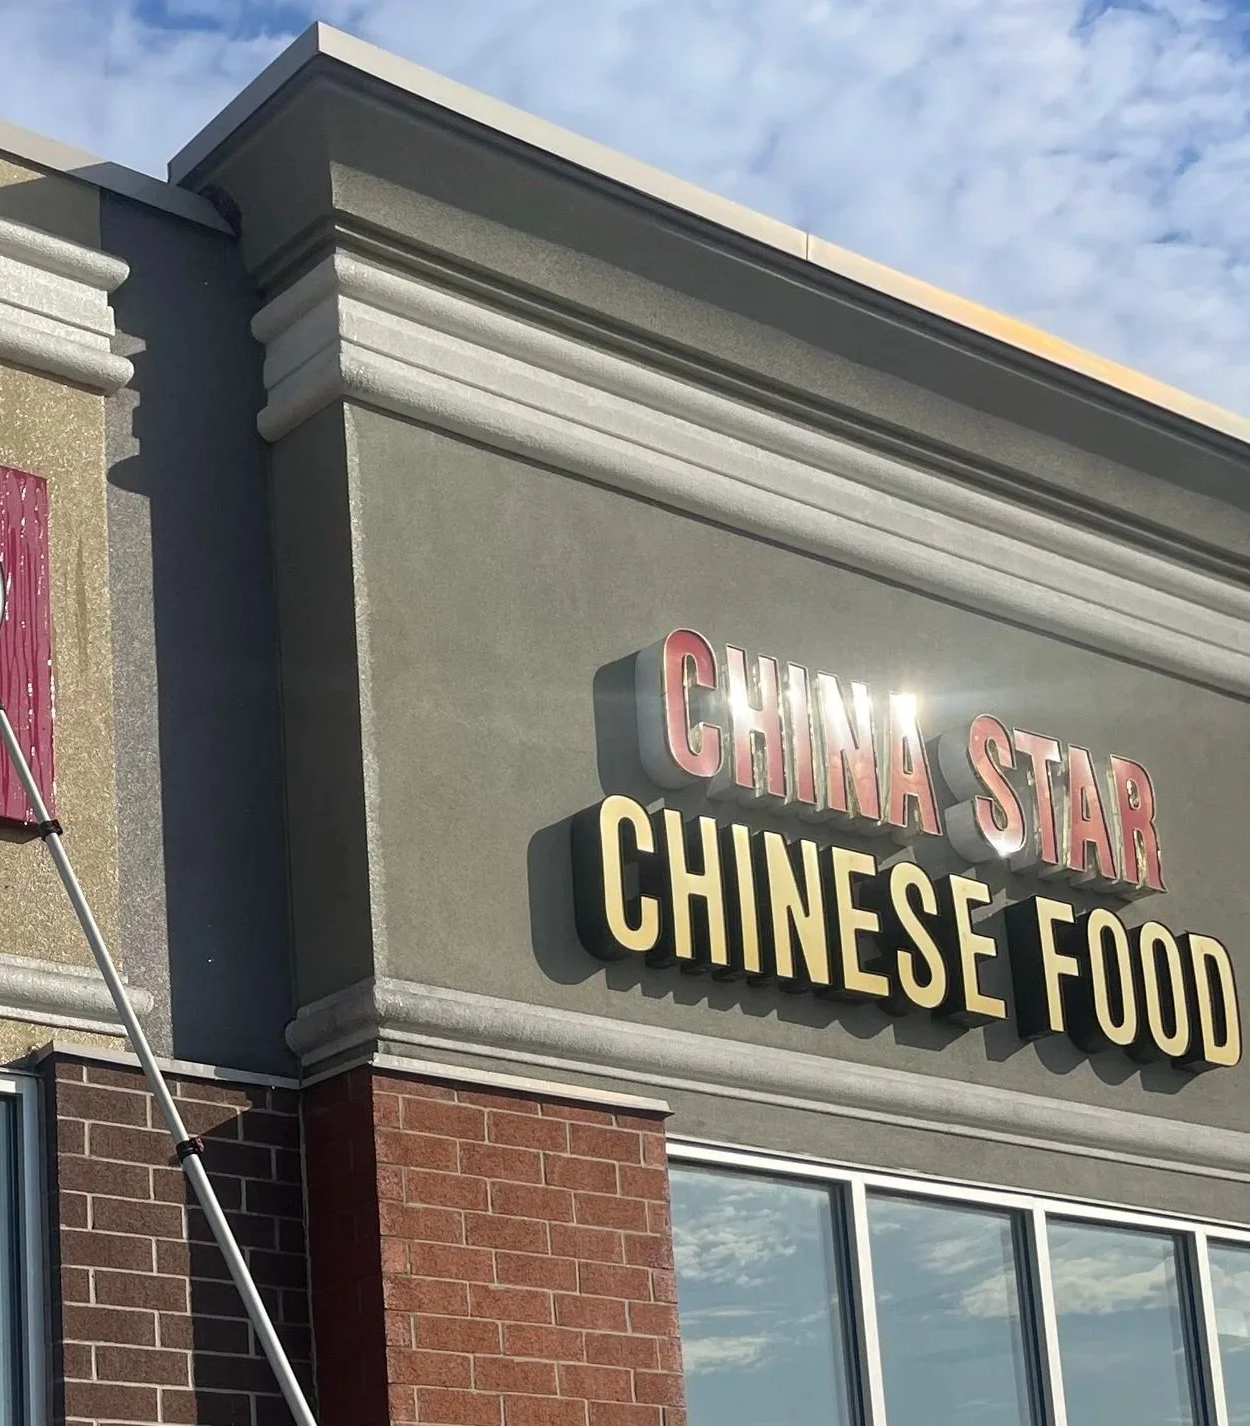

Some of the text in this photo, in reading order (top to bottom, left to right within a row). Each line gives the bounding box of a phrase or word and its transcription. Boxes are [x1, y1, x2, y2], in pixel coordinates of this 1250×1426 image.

[662, 628, 1167, 892] CHINA STAR
[598, 794, 1242, 1067] CHINESE FOOD
